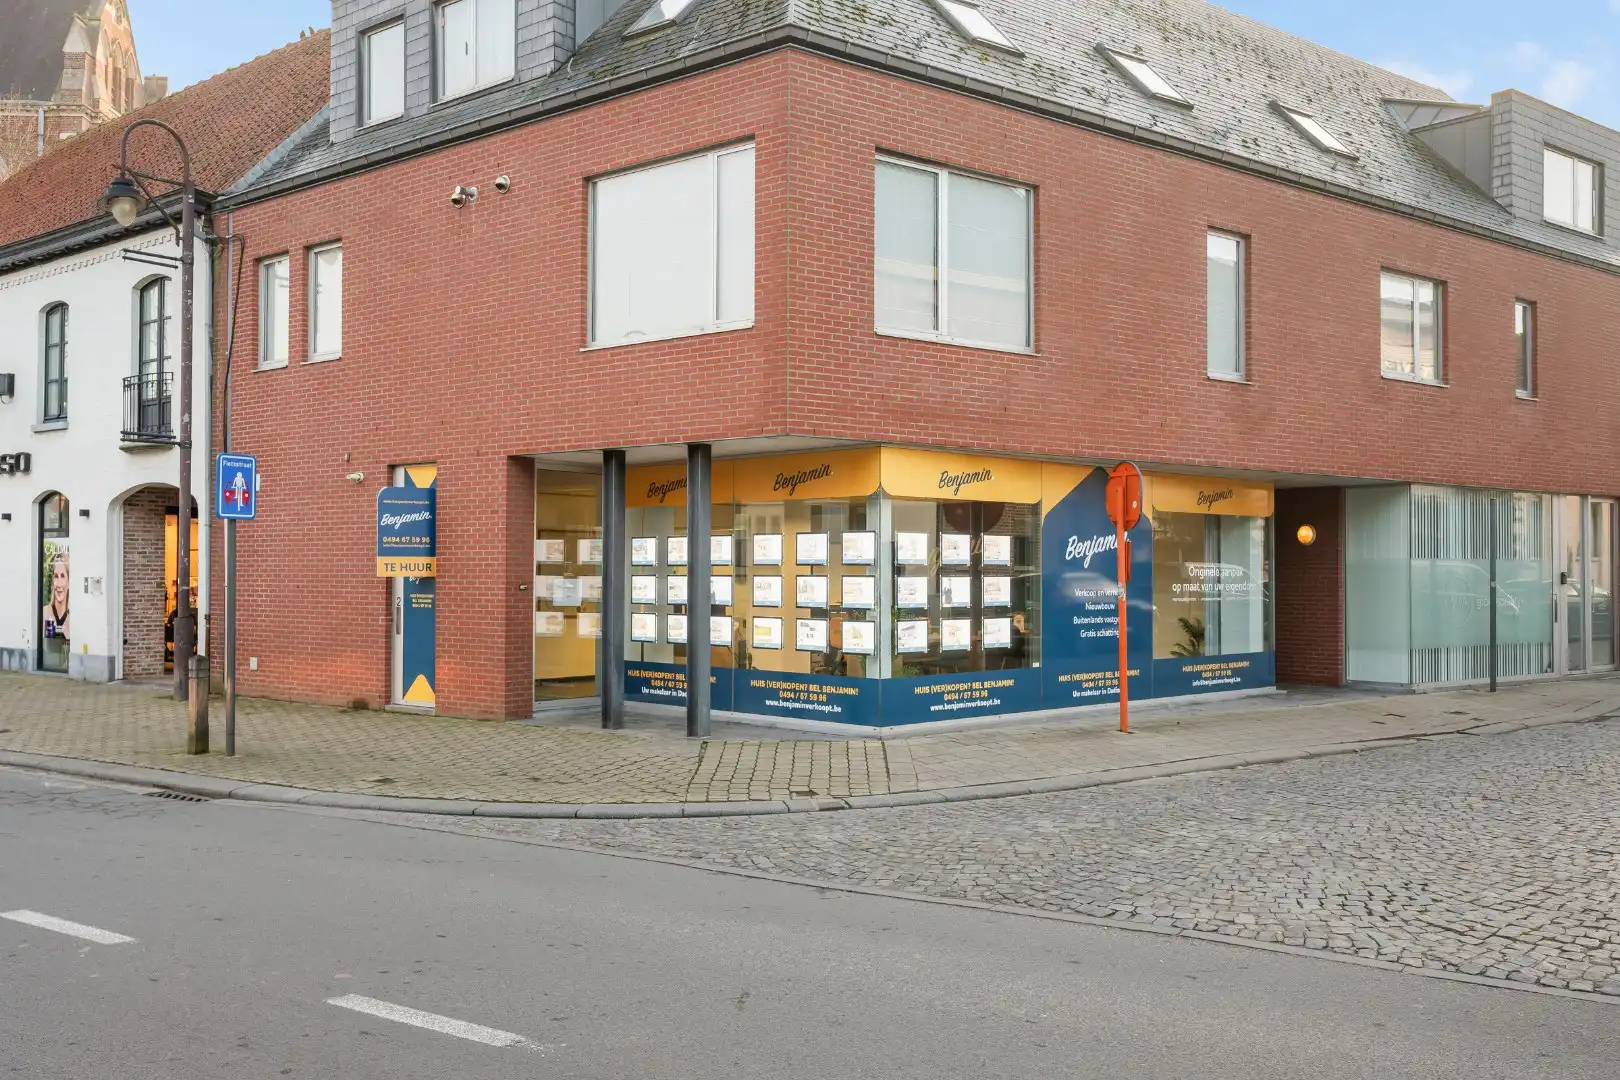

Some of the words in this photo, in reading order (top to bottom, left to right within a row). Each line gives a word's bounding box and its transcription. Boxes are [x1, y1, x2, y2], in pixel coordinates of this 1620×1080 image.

[647, 476, 687, 503] Benjami
[384, 563, 396, 571] TE
[400, 563, 432, 572] HUUR
[1189, 566, 1220, 579] Originele
[1172, 584, 1182, 594] op
[1183, 582, 1200, 591] maat
[1075, 589, 1096, 598] Verkoop
[1085, 602, 1115, 610] Nieuwbouw
[1074, 616, 1104, 624] Buitenlands
[1080, 629, 1096, 638] Gratis
[822, 686, 858, 696] BENJAMIN!
[914, 686, 930, 694] HUIS
[984, 679, 1014, 688] BENJAMIN!
[650, 688, 671, 696] makelaar
[780, 690, 794, 698] 0494
[800, 692, 808, 700] 67
[766, 700, 842, 713] www.benjaminverkoopt.be
[930, 698, 1000, 712] www.benjaminverkoopt.be
